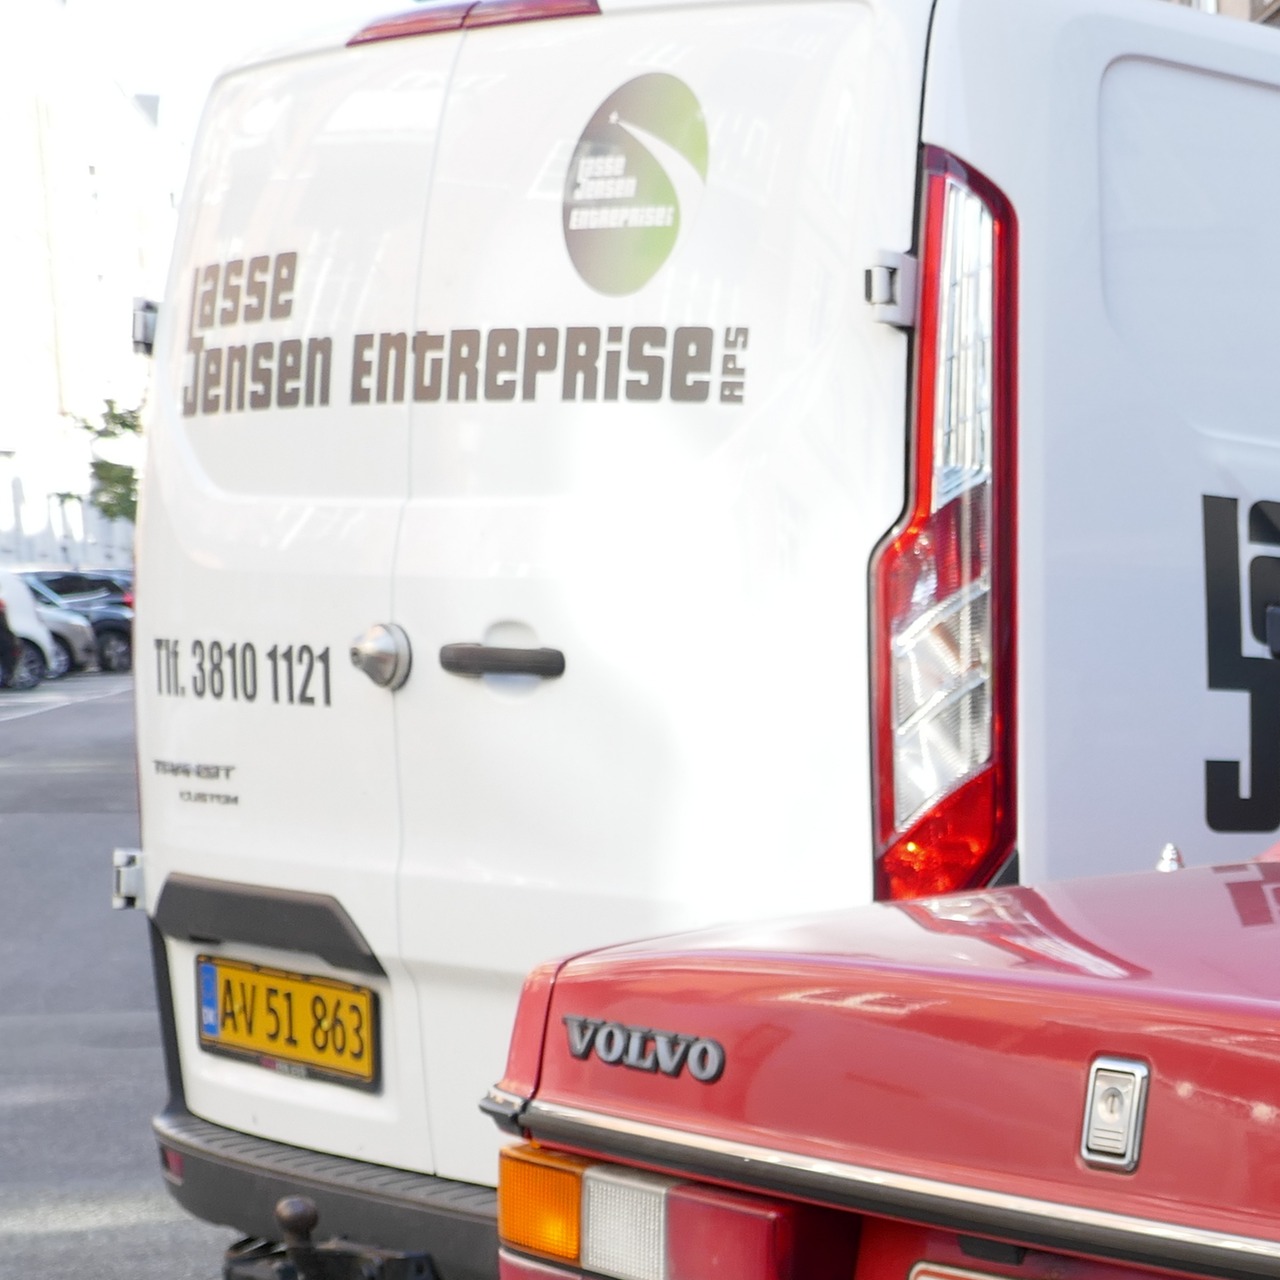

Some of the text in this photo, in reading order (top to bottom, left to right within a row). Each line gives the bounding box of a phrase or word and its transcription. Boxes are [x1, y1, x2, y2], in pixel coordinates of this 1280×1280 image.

[187, 252, 298, 351] Lasse
[183, 335, 332, 417] Jensen
[154, 638, 331, 707] Tlf. 3810 1121
[221, 979, 364, 1058] AV 51 863
[562, 1013, 726, 1085] VOLVO
